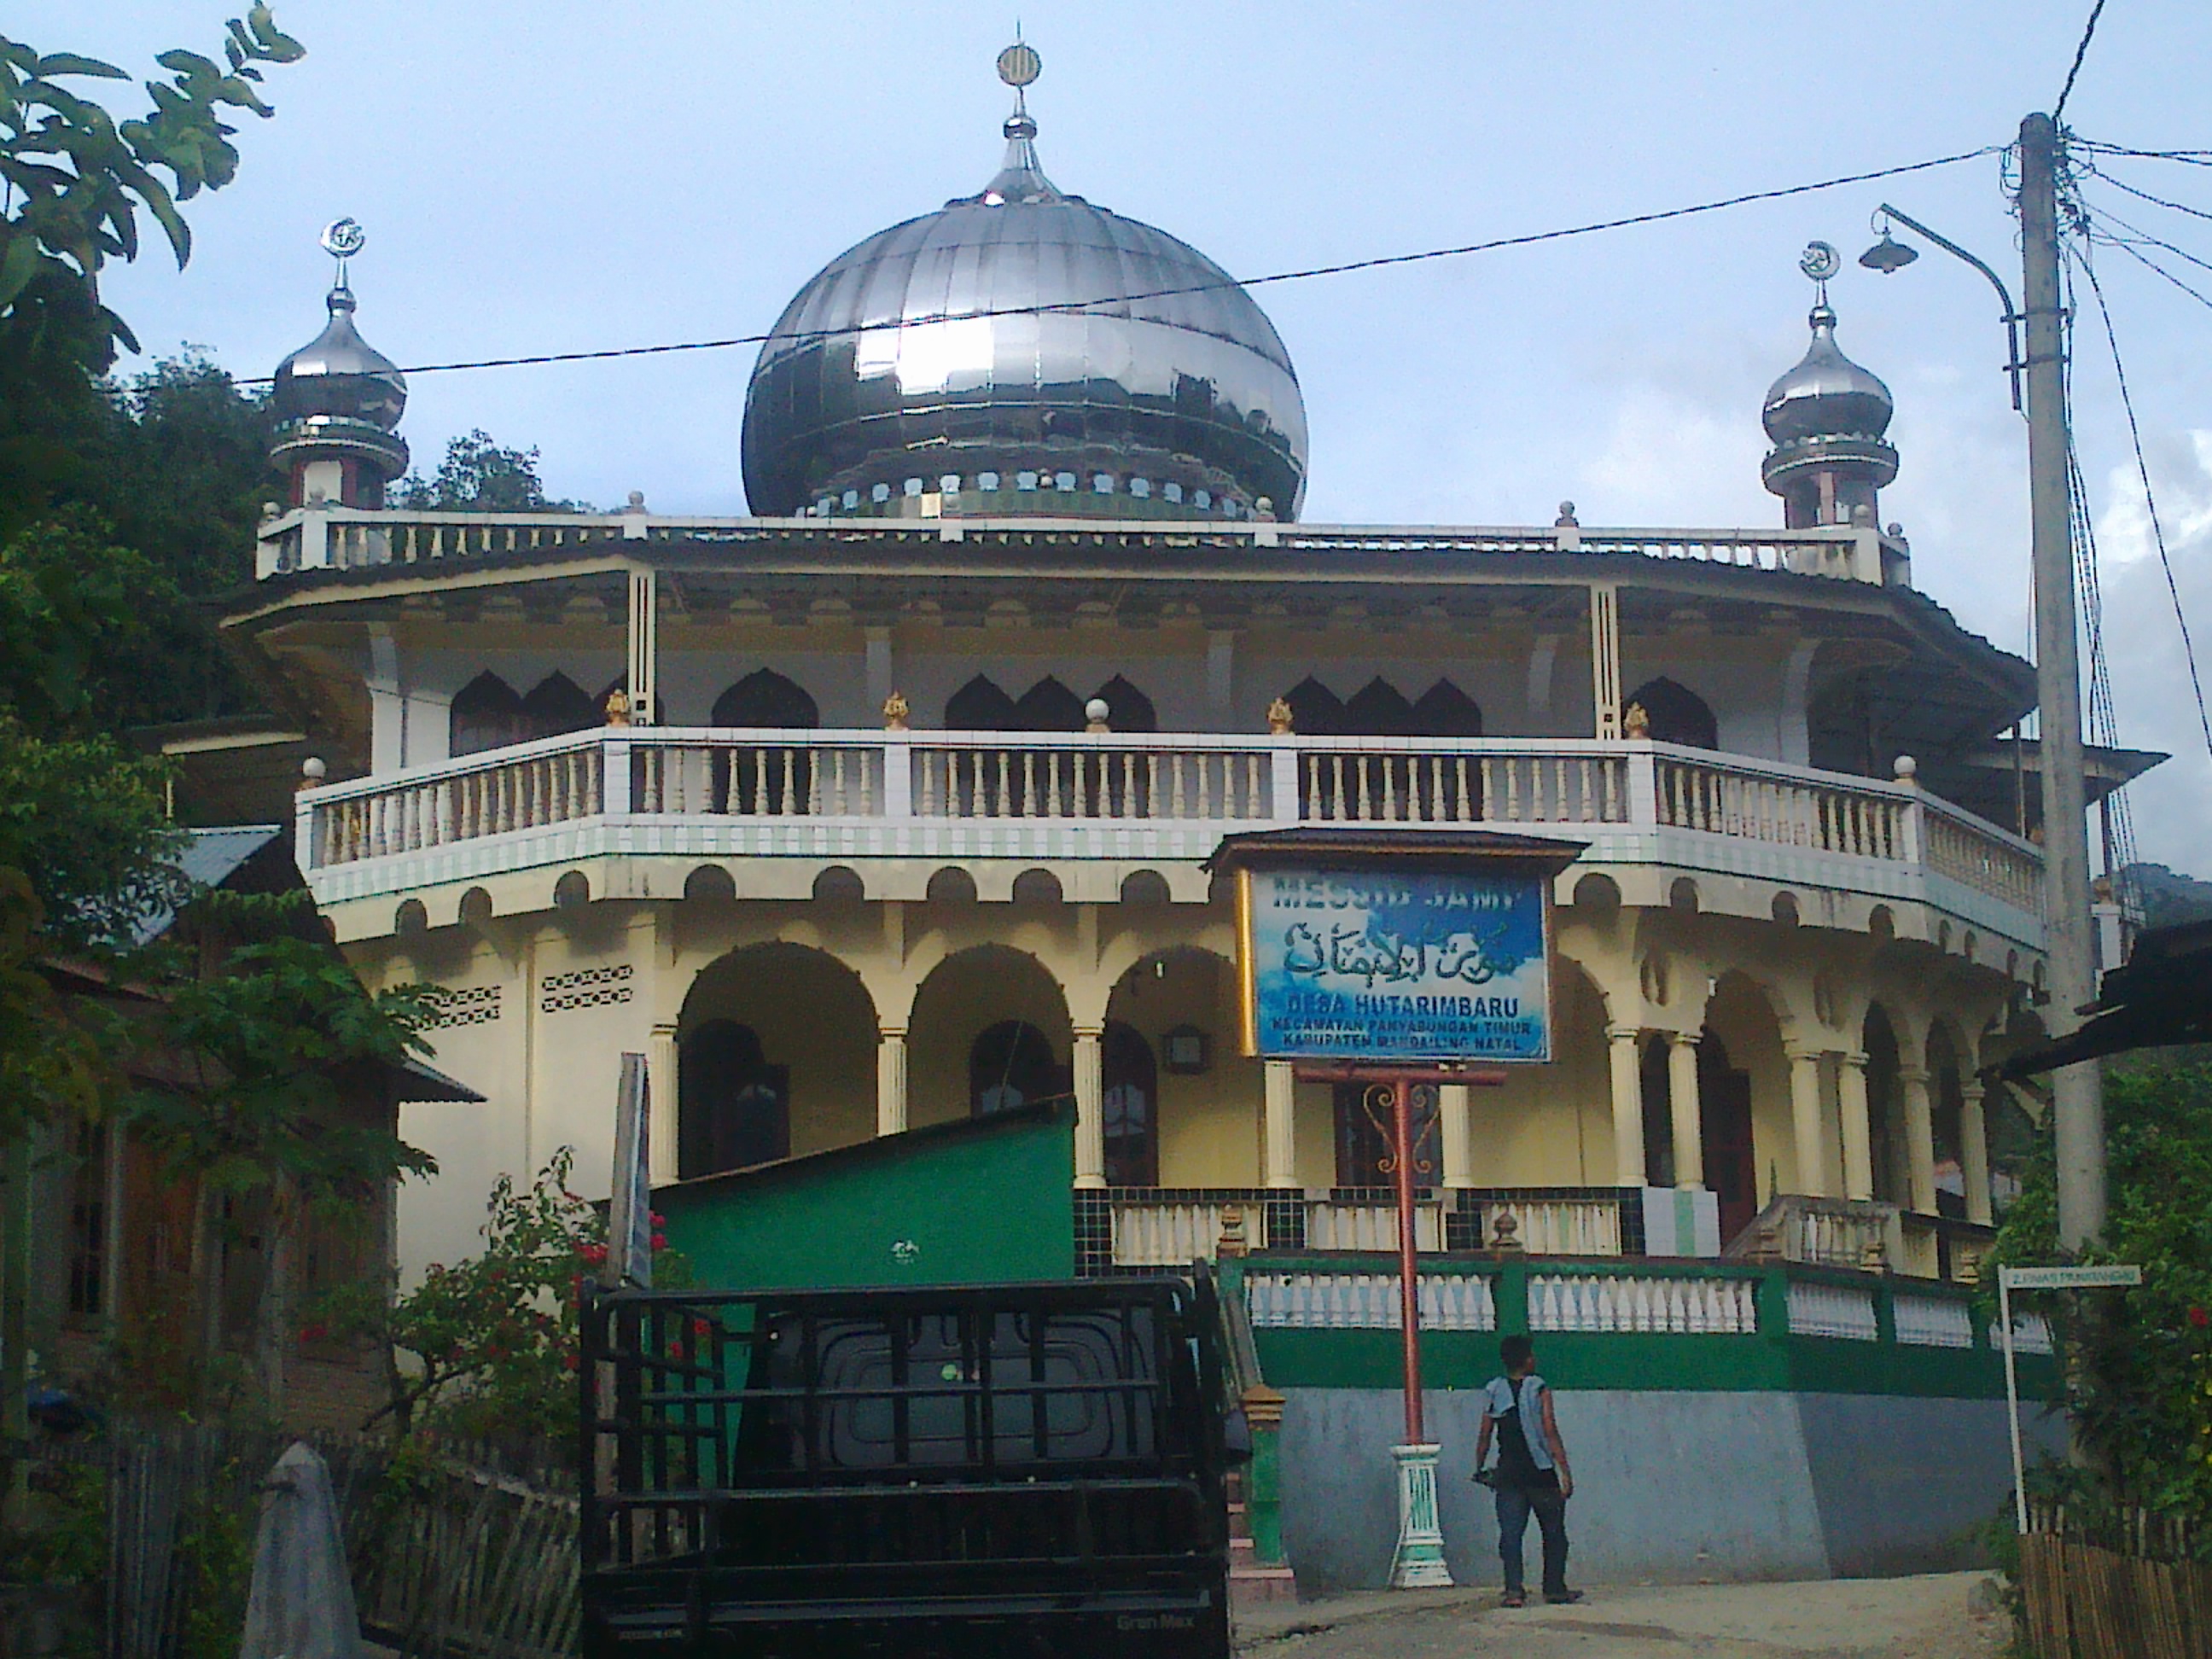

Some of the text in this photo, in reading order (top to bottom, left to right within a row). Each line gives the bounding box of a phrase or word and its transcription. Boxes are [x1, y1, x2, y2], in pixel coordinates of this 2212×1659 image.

[1287, 993, 1519, 1018] DESA HUTARIMBARU
[1283, 1033, 1371, 1046] KABUPATEN
[1475, 1036, 1521, 1051] NATAL
